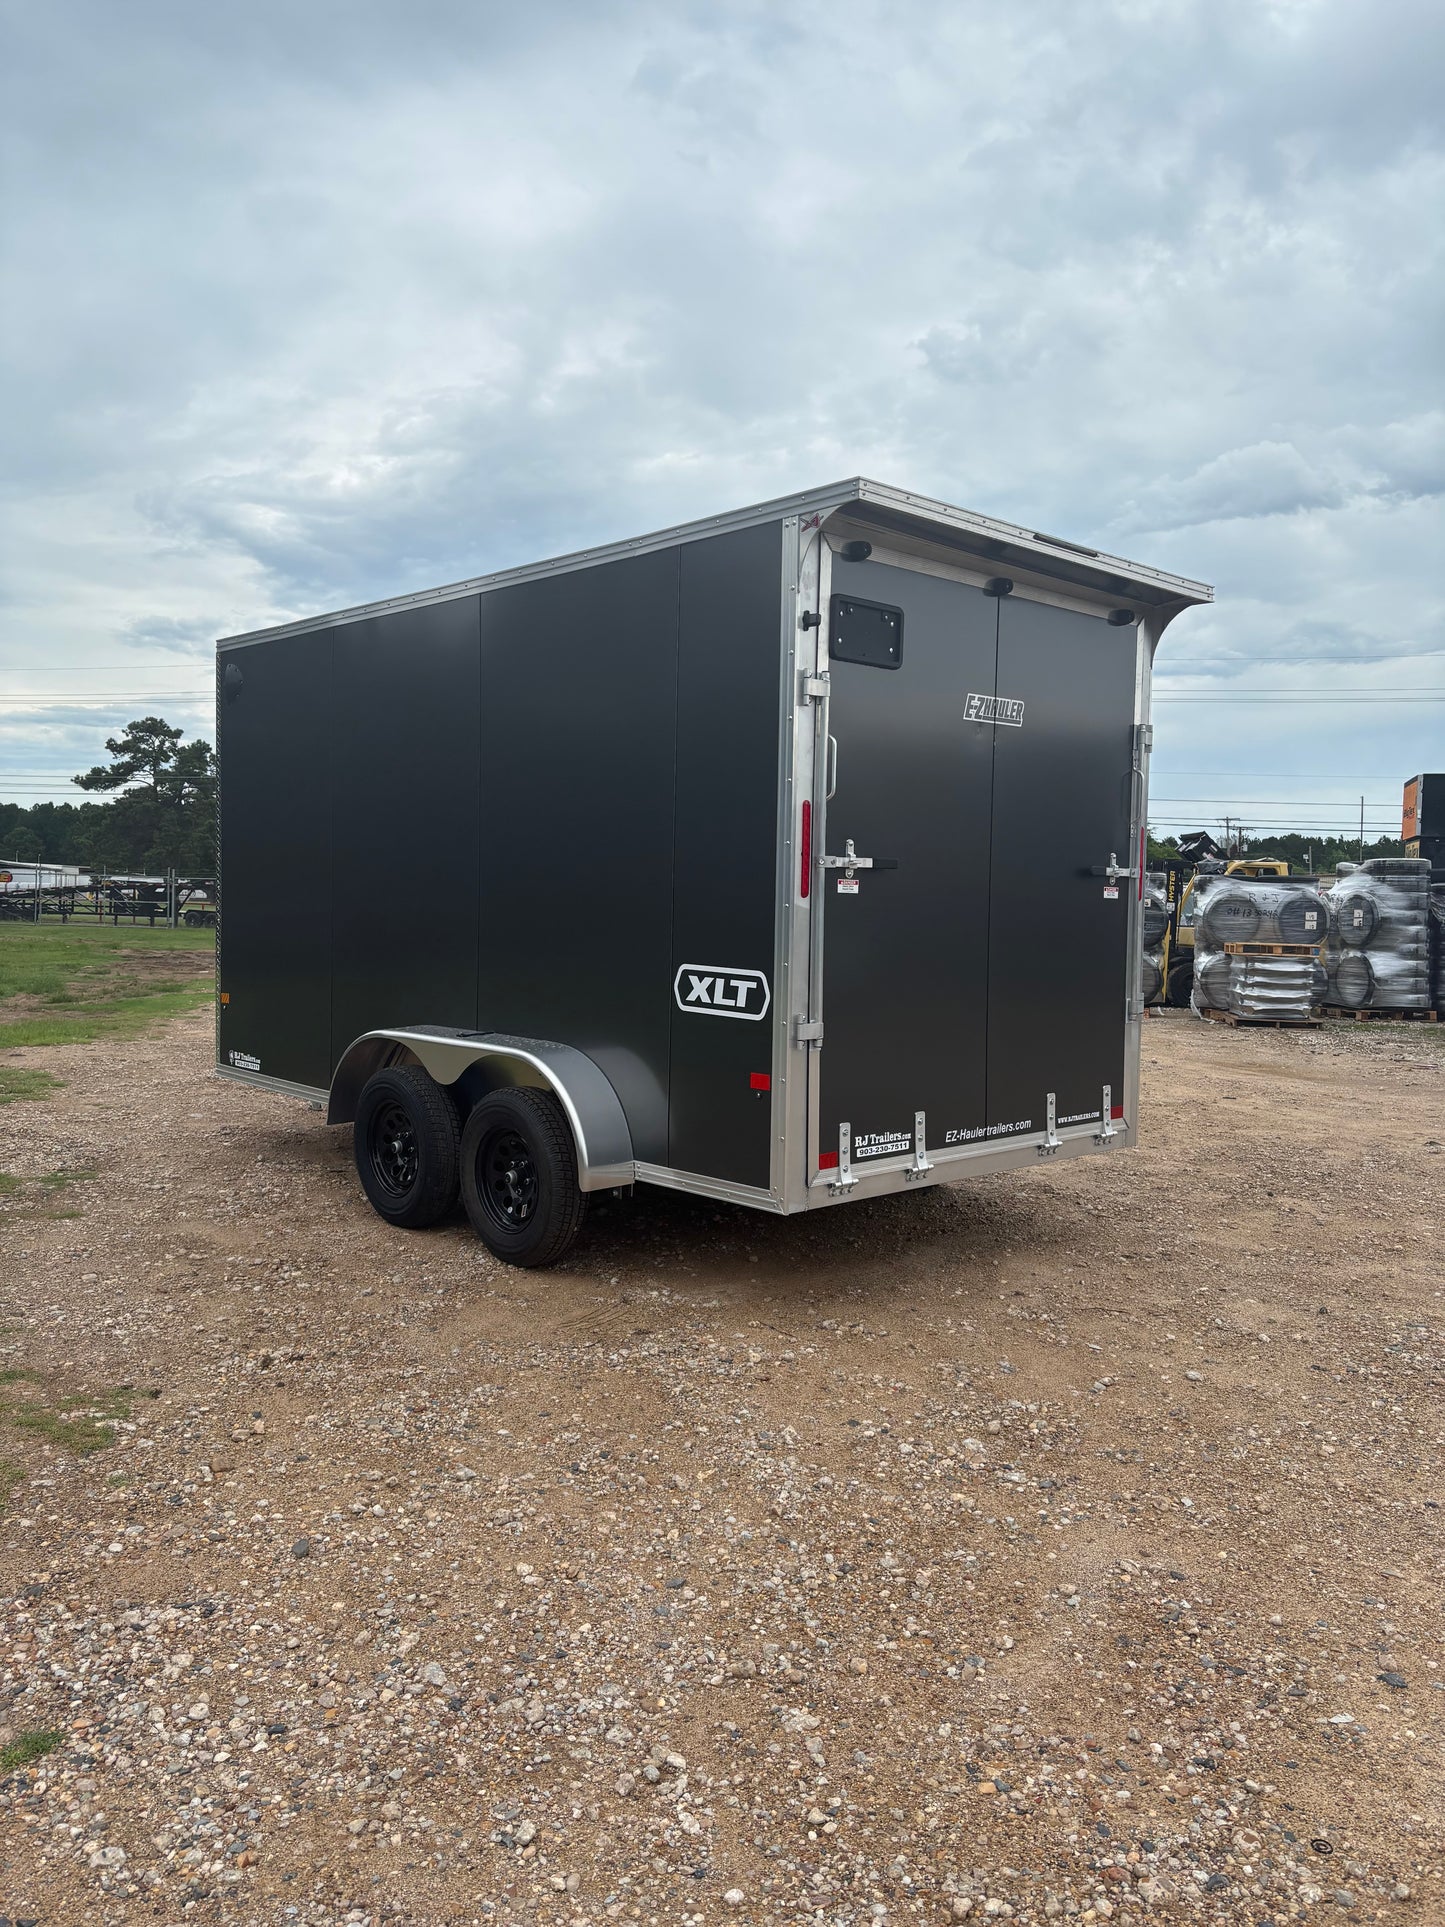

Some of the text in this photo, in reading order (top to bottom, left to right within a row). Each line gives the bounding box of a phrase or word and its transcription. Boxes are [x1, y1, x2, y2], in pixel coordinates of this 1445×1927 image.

[1168, 870, 1176, 902] HYSTER
[685, 975, 757, 1008] XLT
[854, 1134, 869, 1148] RJ
[859, 1142, 908, 1156] 903-230-7511
